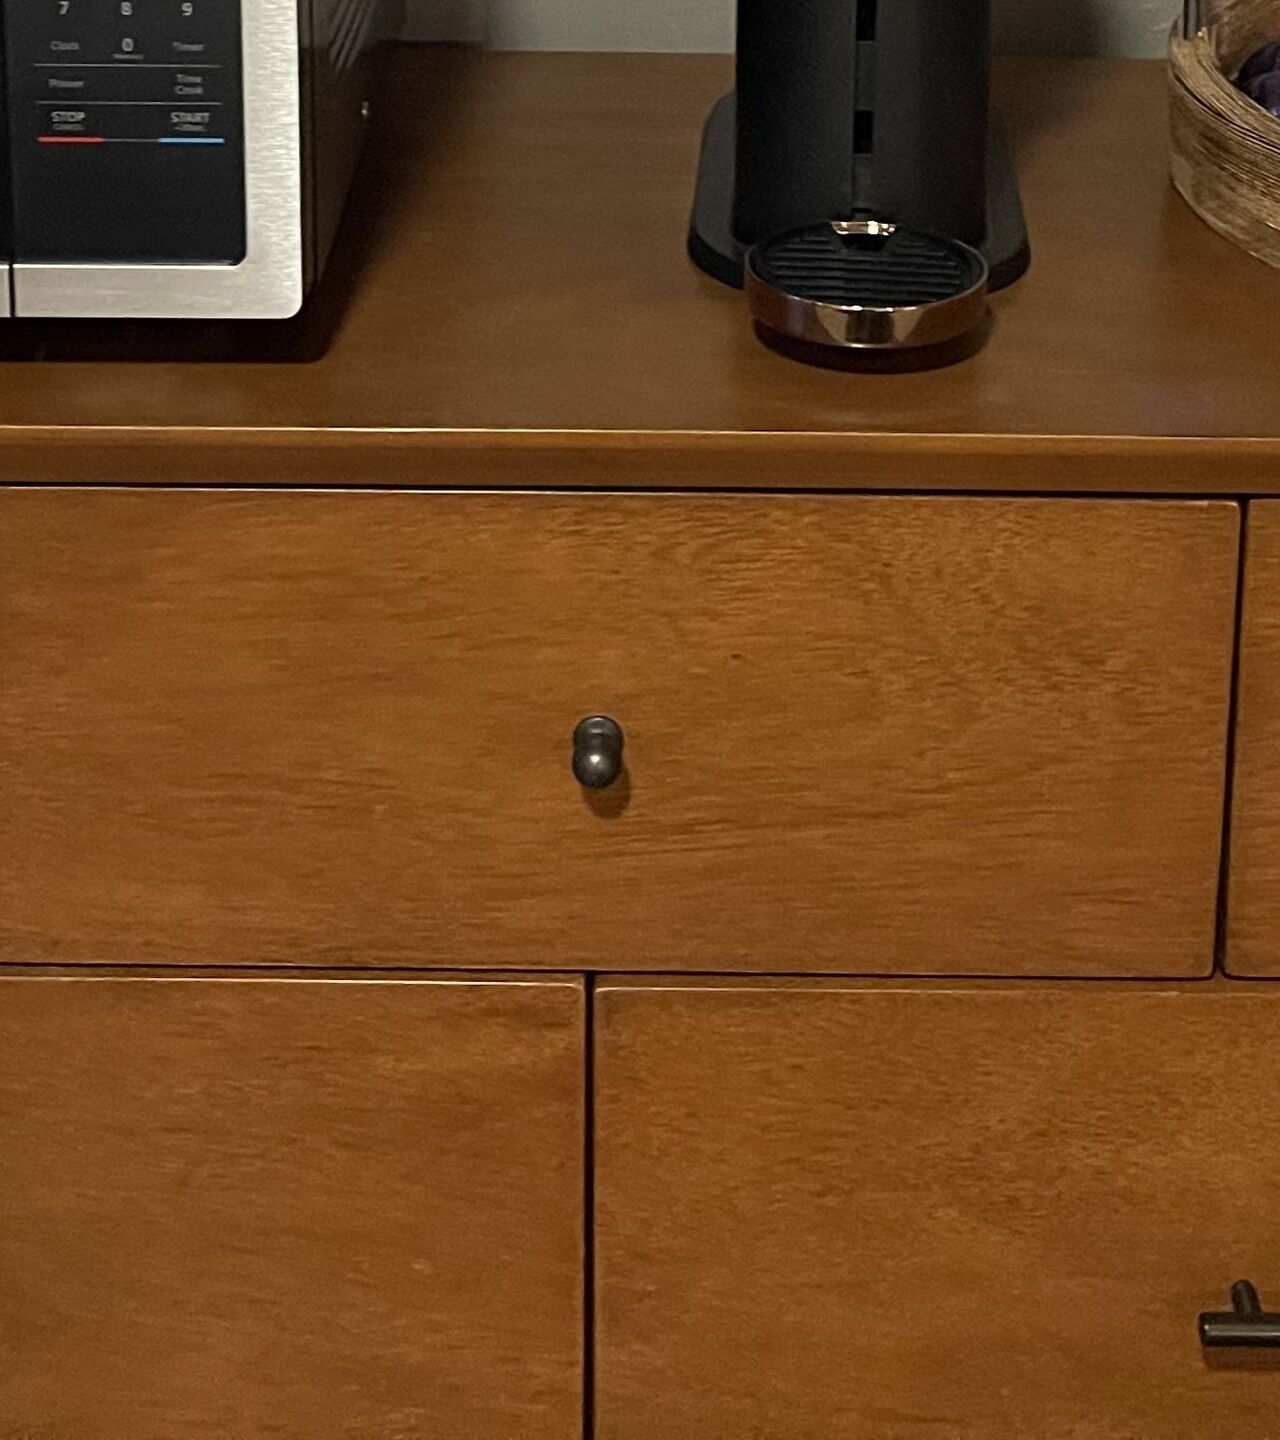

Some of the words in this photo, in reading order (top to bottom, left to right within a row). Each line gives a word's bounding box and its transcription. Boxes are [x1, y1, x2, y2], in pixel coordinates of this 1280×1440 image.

[58, 1, 70, 15] 7
[120, 1, 133, 16] 8
[181, 2, 193, 16] 9
[121, 37, 134, 52] 0
[50, 111, 86, 122] STOP
[170, 112, 211, 123] START
